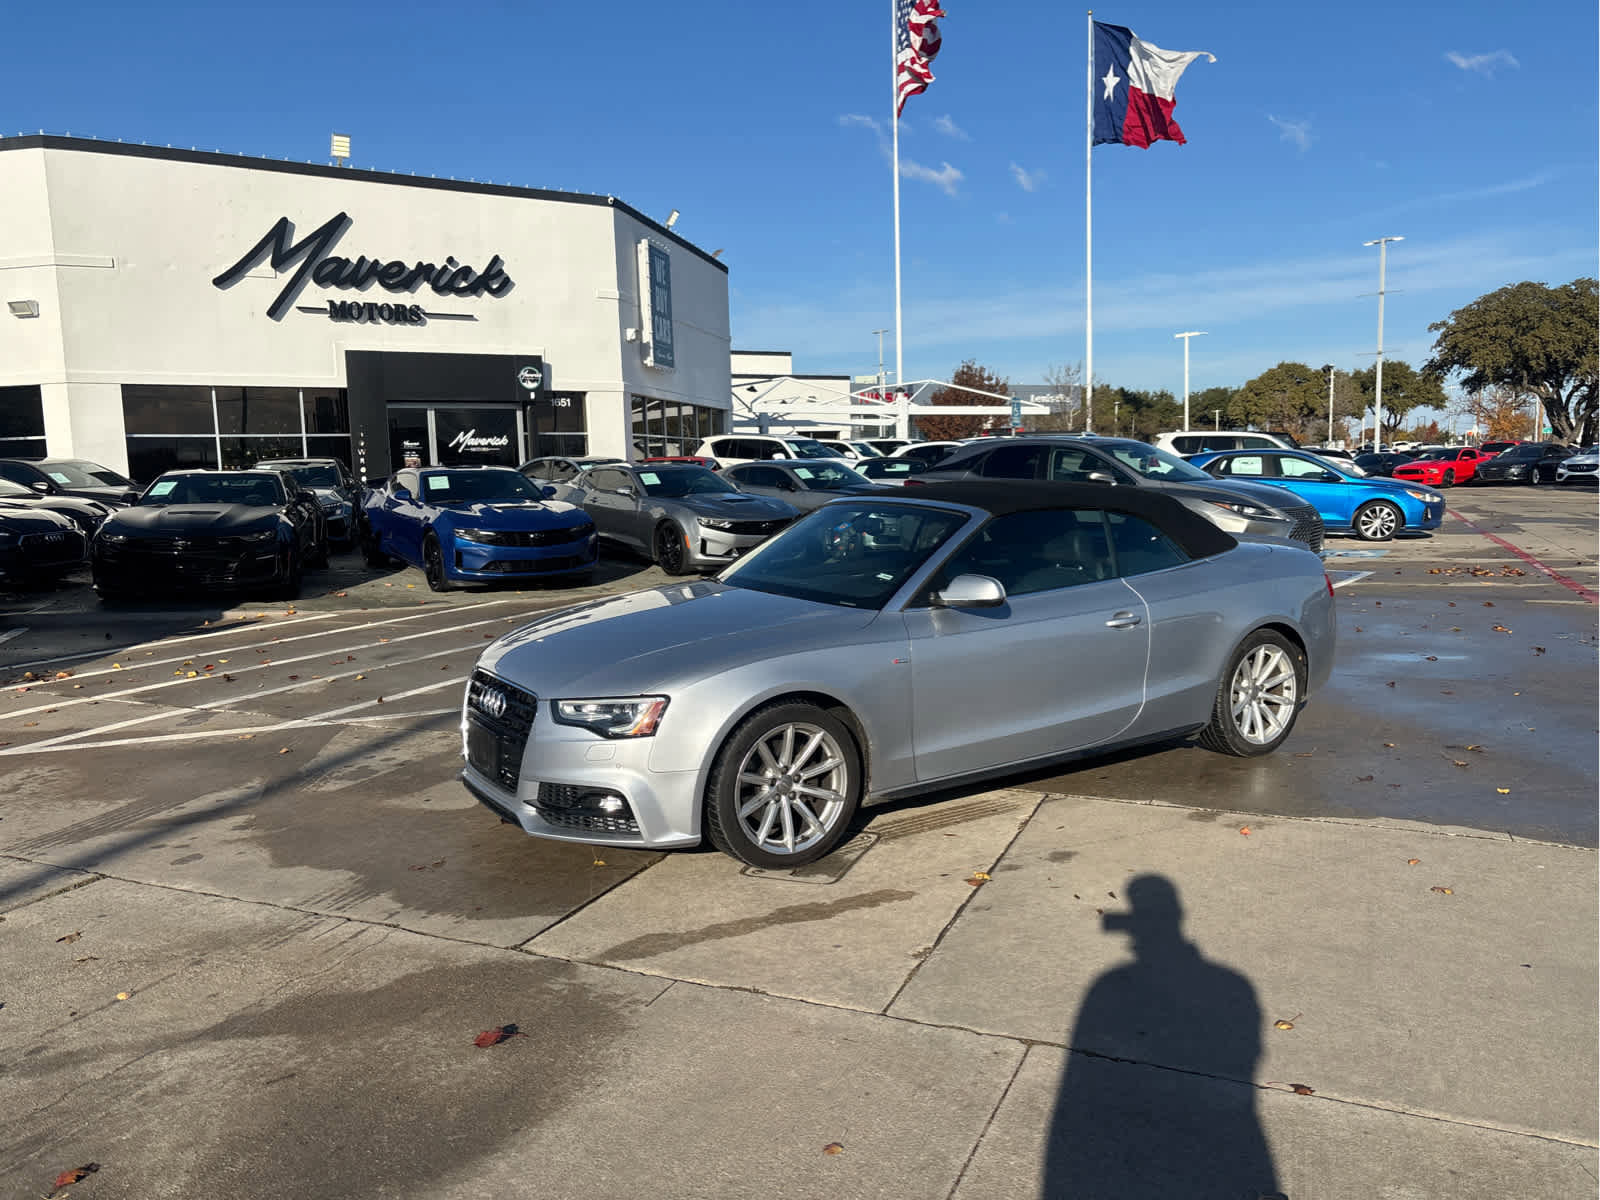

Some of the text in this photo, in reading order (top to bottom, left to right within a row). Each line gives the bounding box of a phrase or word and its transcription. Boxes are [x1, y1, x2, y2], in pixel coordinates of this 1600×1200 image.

[212, 211, 512, 322] Maverick
[327, 300, 424, 325] MOTORS
[655, 315, 672, 345] CARS
[551, 397, 571, 407] 1651
[448, 428, 509, 453] Maverick
